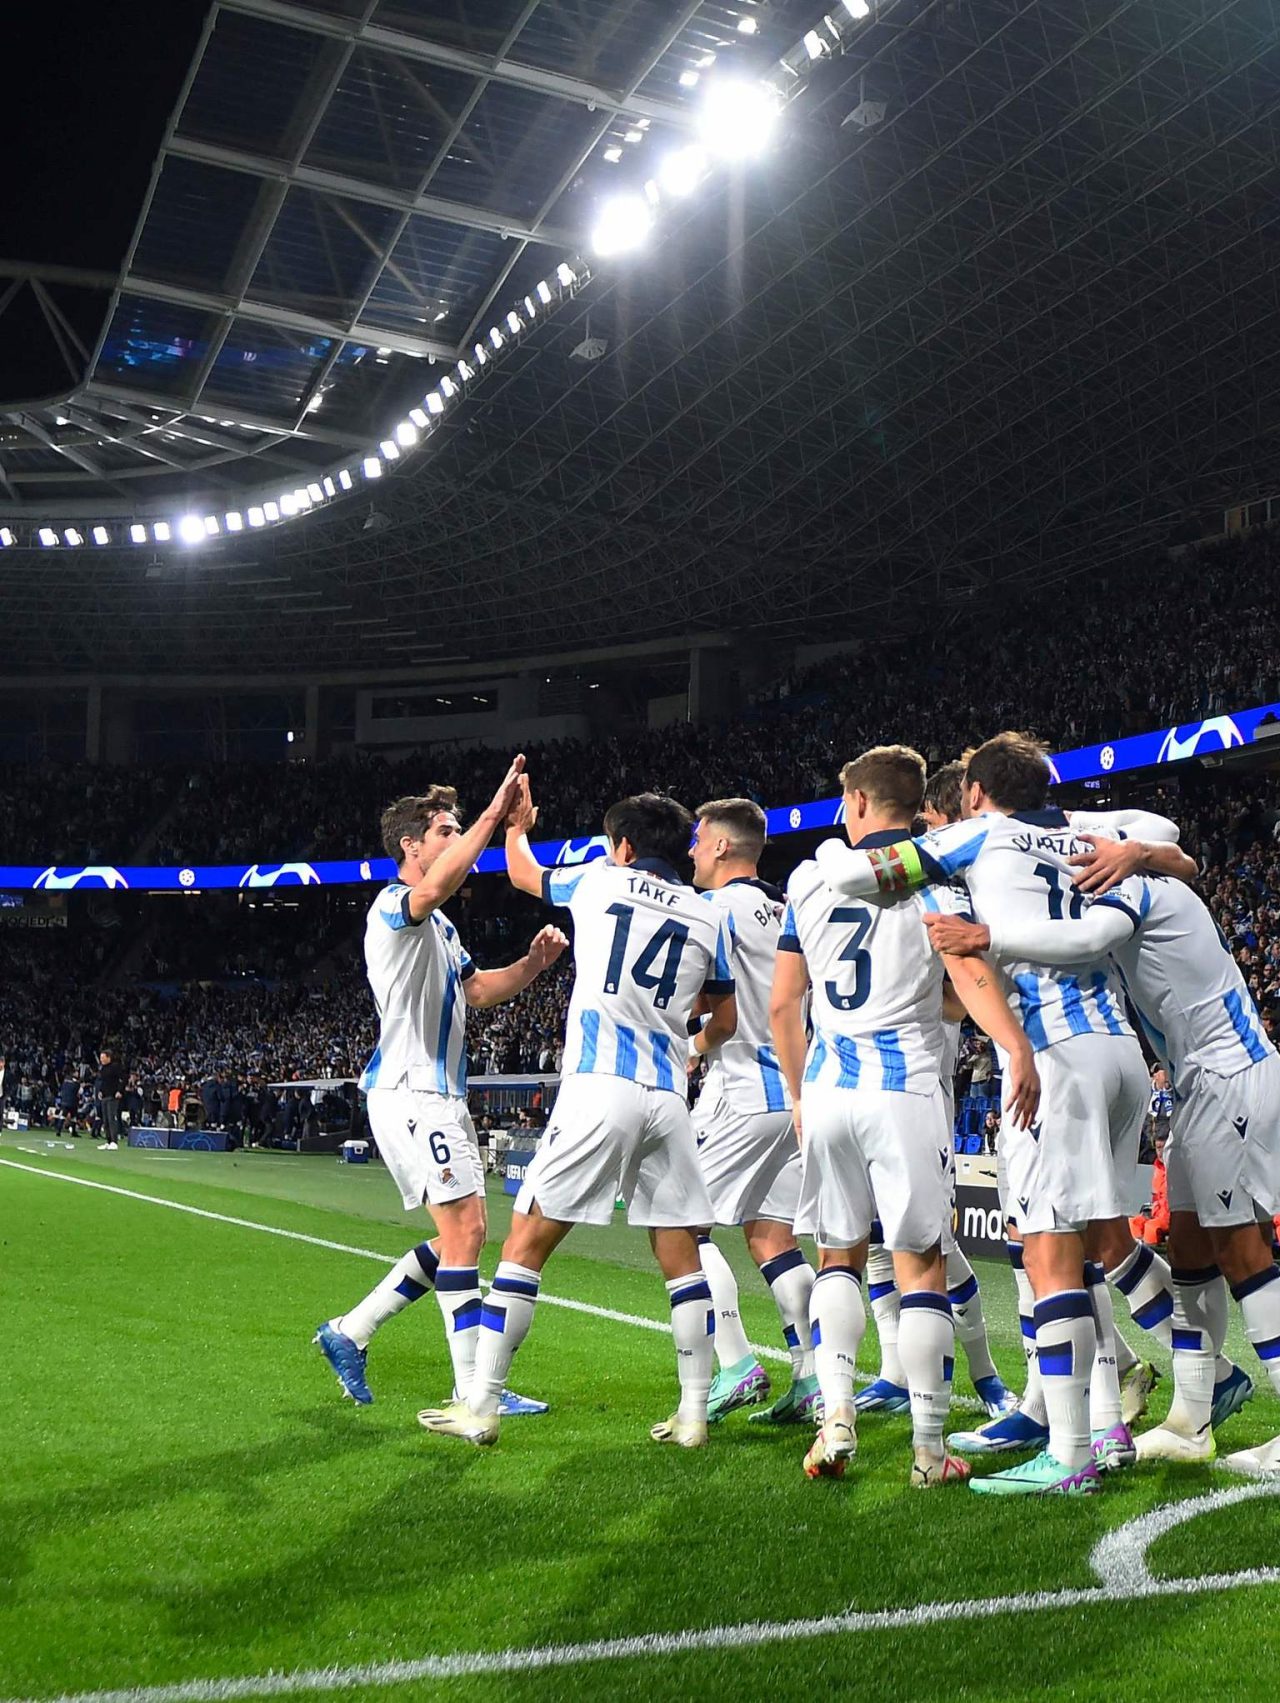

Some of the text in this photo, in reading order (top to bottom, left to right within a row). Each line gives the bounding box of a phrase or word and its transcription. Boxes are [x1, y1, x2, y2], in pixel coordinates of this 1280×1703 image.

[603, 902, 690, 1010] 14
[824, 907, 873, 1011] 3
[429, 1131, 451, 1165] 6
[721, 1310, 738, 1319] RS
[1098, 1356, 1115, 1365] RS
[913, 1391, 933, 1401] RS
